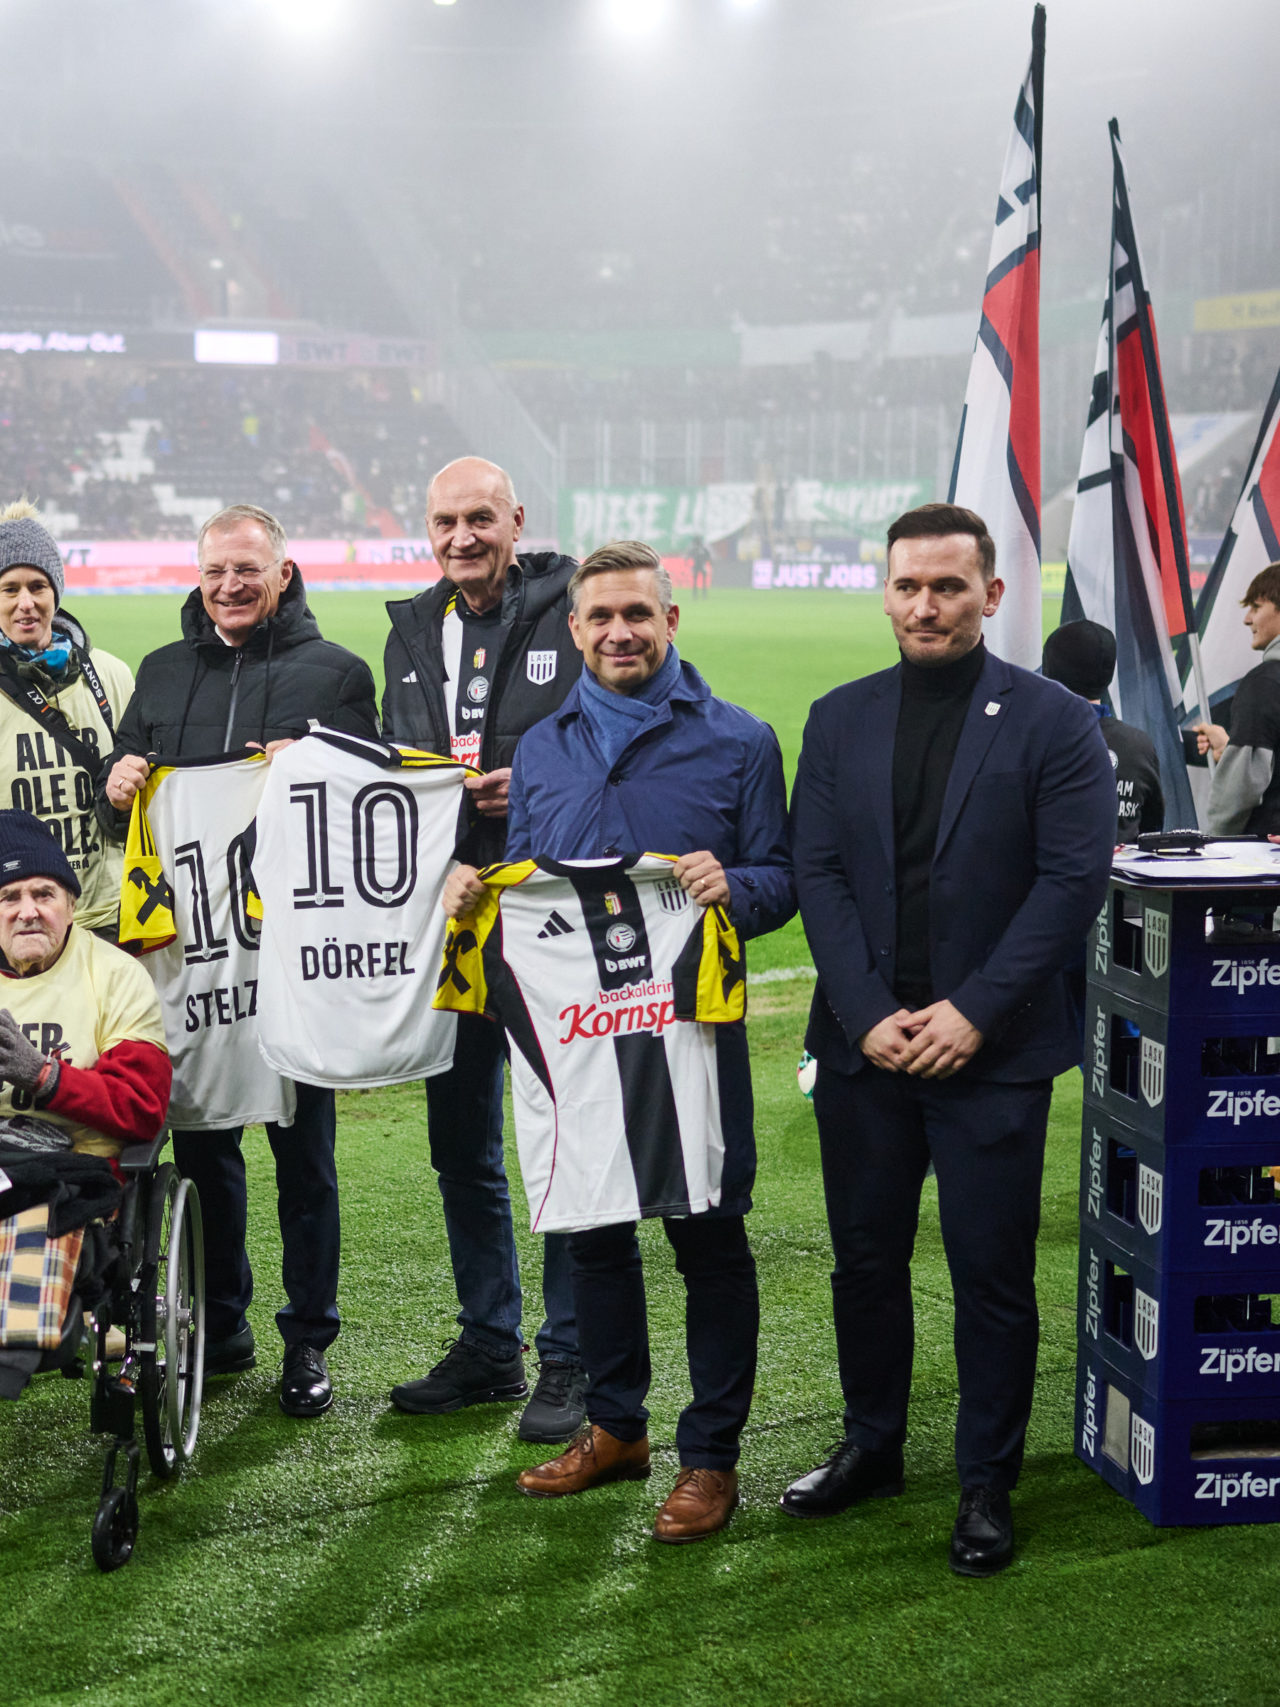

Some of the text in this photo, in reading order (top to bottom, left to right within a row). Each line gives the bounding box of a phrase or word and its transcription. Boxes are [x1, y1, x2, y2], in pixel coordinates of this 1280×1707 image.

[773, 564, 877, 588] JUST JOBS
[531, 654, 554, 663] LASK
[82, 662, 104, 698] SONY
[1116, 780, 1134, 798] AM
[1118, 801, 1140, 817] ASK
[290, 781, 419, 910] 10
[657, 880, 681, 892] LAS
[1146, 912, 1168, 935] LASK
[300, 937, 416, 981] DÖRFEL
[617, 955, 646, 971] BWT
[1211, 958, 1280, 994] Zipfe
[185, 979, 259, 1033] STELZ
[558, 1000, 676, 1045] Kornsp
[1092, 1005, 1108, 1099] Zipfer
[1143, 1042, 1164, 1065] LASK
[1206, 1089, 1280, 1125] Zipfe
[1087, 1127, 1105, 1219] Zipfer
[1141, 1169, 1161, 1194] LASK
[1204, 1218, 1280, 1254] Zipfe
[1085, 1248, 1099, 1341] Zipfer
[1136, 1296, 1157, 1321] LASK
[1082, 1366, 1097, 1458] Zipfer
[1133, 1418, 1153, 1445] LASK
[1194, 1471, 1280, 1507] Zipfer
